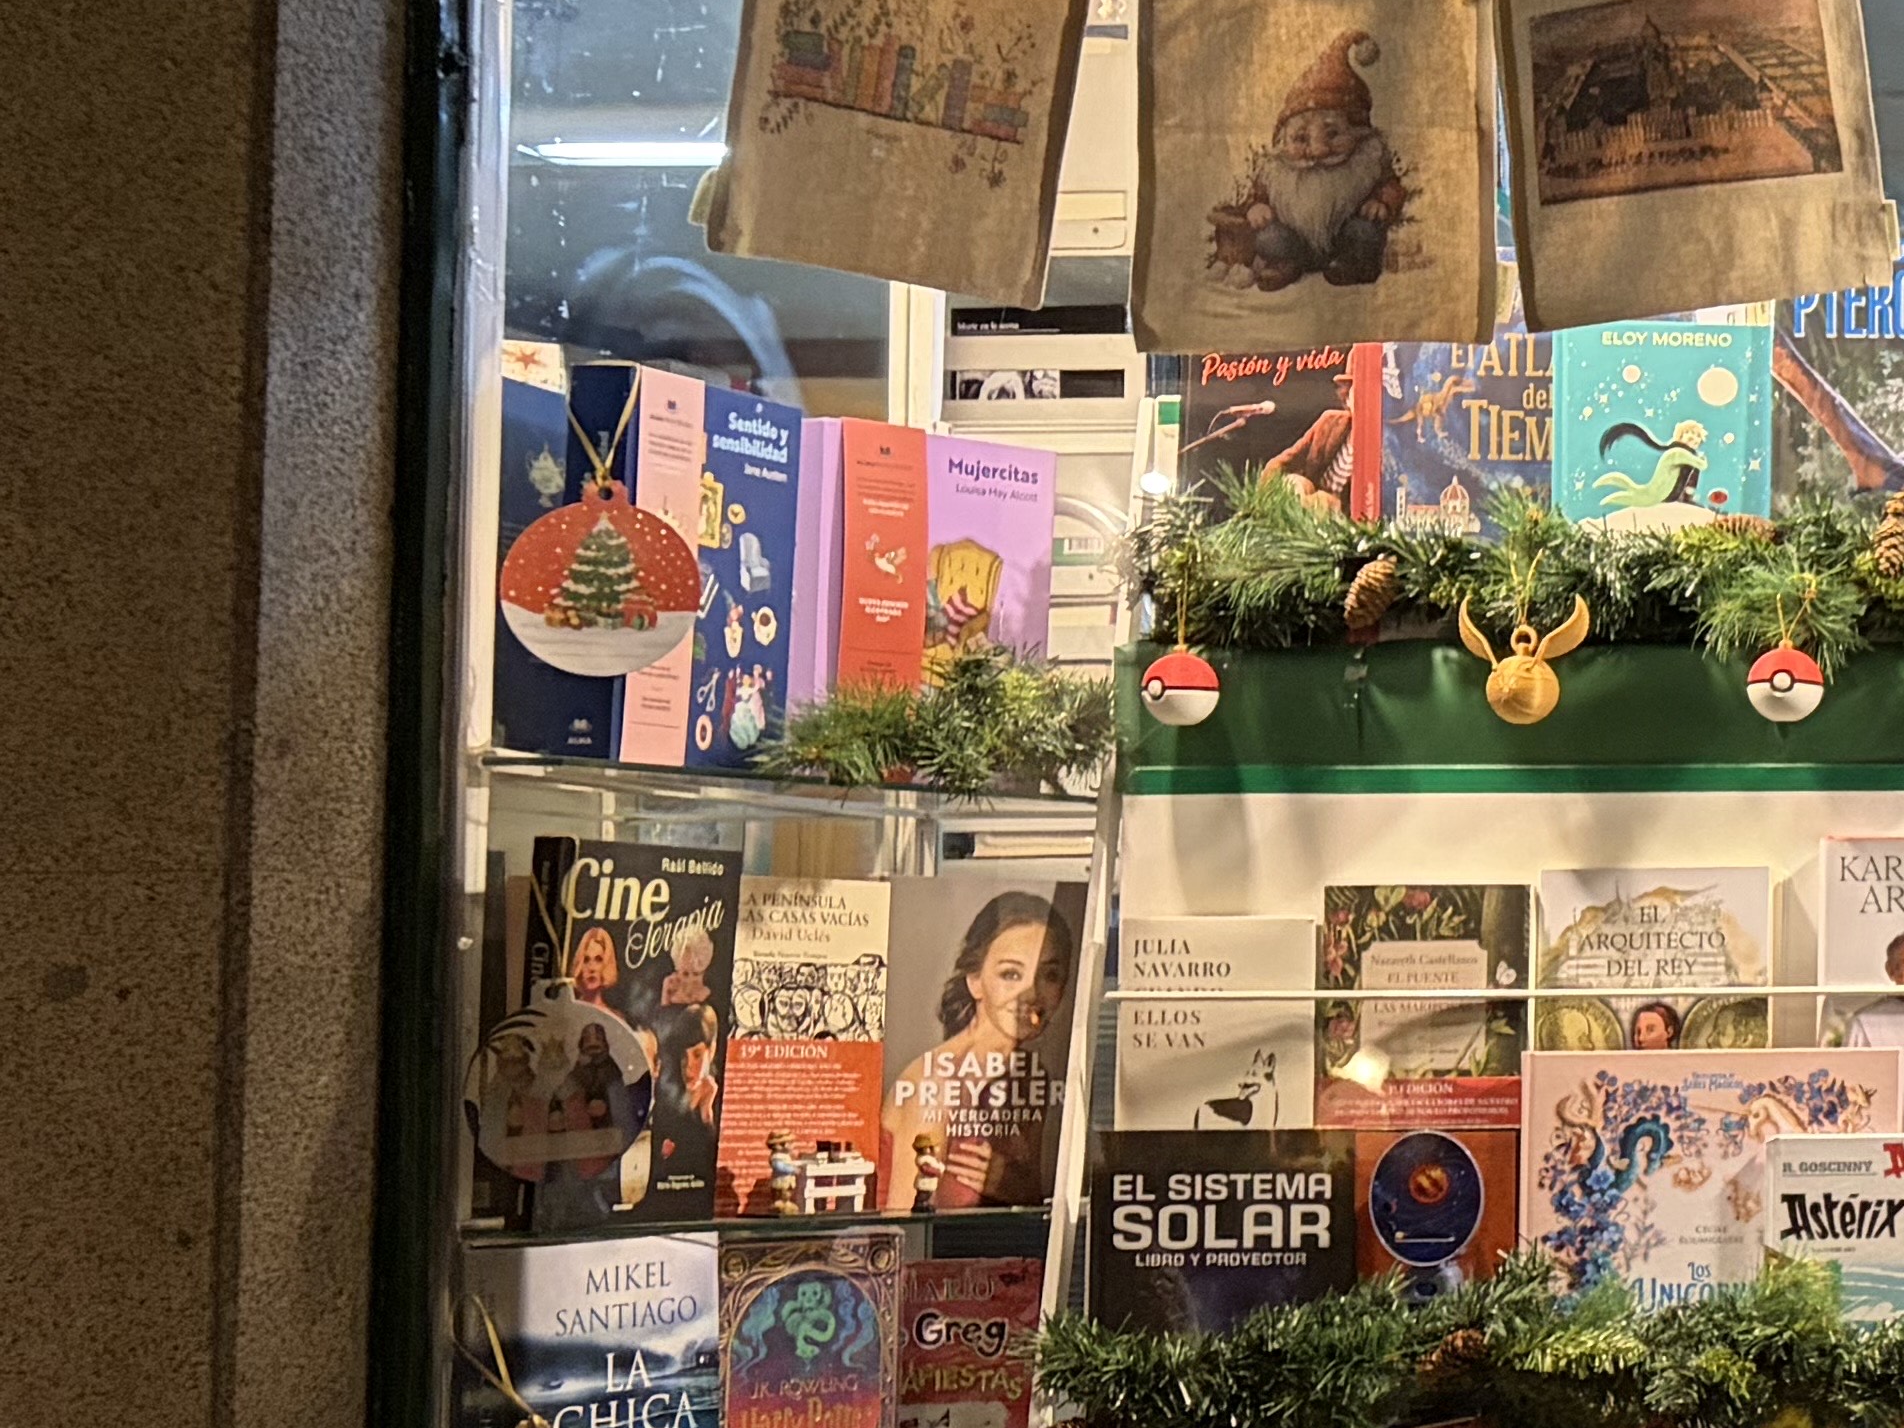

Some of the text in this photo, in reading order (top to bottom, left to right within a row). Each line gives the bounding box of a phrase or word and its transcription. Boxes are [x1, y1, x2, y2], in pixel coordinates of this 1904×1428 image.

[1602, 332, 1731, 347] ELOY MORENO
[1202, 348, 1343, 386] Pasión y vida
[728, 412, 788, 445] Sentido y
[713, 433, 788, 464] sensibilidad
[948, 458, 1039, 485] Mujercitas
[956, 484, 985, 497] Louisa
[1009, 488, 1038, 503] Alcott
[566, 857, 670, 921] Cine
[769, 910, 869, 926] CASAS VACÍAS
[1639, 906, 1665, 924] EL
[625, 897, 725, 969] Terapia
[751, 927, 792, 941] David
[1579, 930, 1726, 951] ARQUITECTO
[1132, 939, 1190, 957] JULIA
[1132, 961, 1231, 978] NAVARRO
[1606, 958, 1698, 977] DEL REY
[1132, 1010, 1201, 1026] ELLOS
[1132, 1031, 1206, 1048] SE VAN
[924, 1052, 1045, 1077] ISABEL
[896, 1080, 1065, 1106] PREYSLER
[924, 1108, 1042, 1123] MI VERDADERA
[946, 1123, 1021, 1137] HISTORIA
[1799, 1160, 1873, 1173] GOSCINNY
[1113, 1174, 1332, 1200] EL SISTEMA
[1113, 1204, 1331, 1250] SOLAR
[1136, 1253, 1306, 1267] LIBRO Y PROYECTOR
[586, 1261, 671, 1296] MIKEL
[556, 1296, 698, 1336] SANTIAGO
[914, 1313, 1007, 1357] Greg
[605, 1349, 652, 1393] LA
